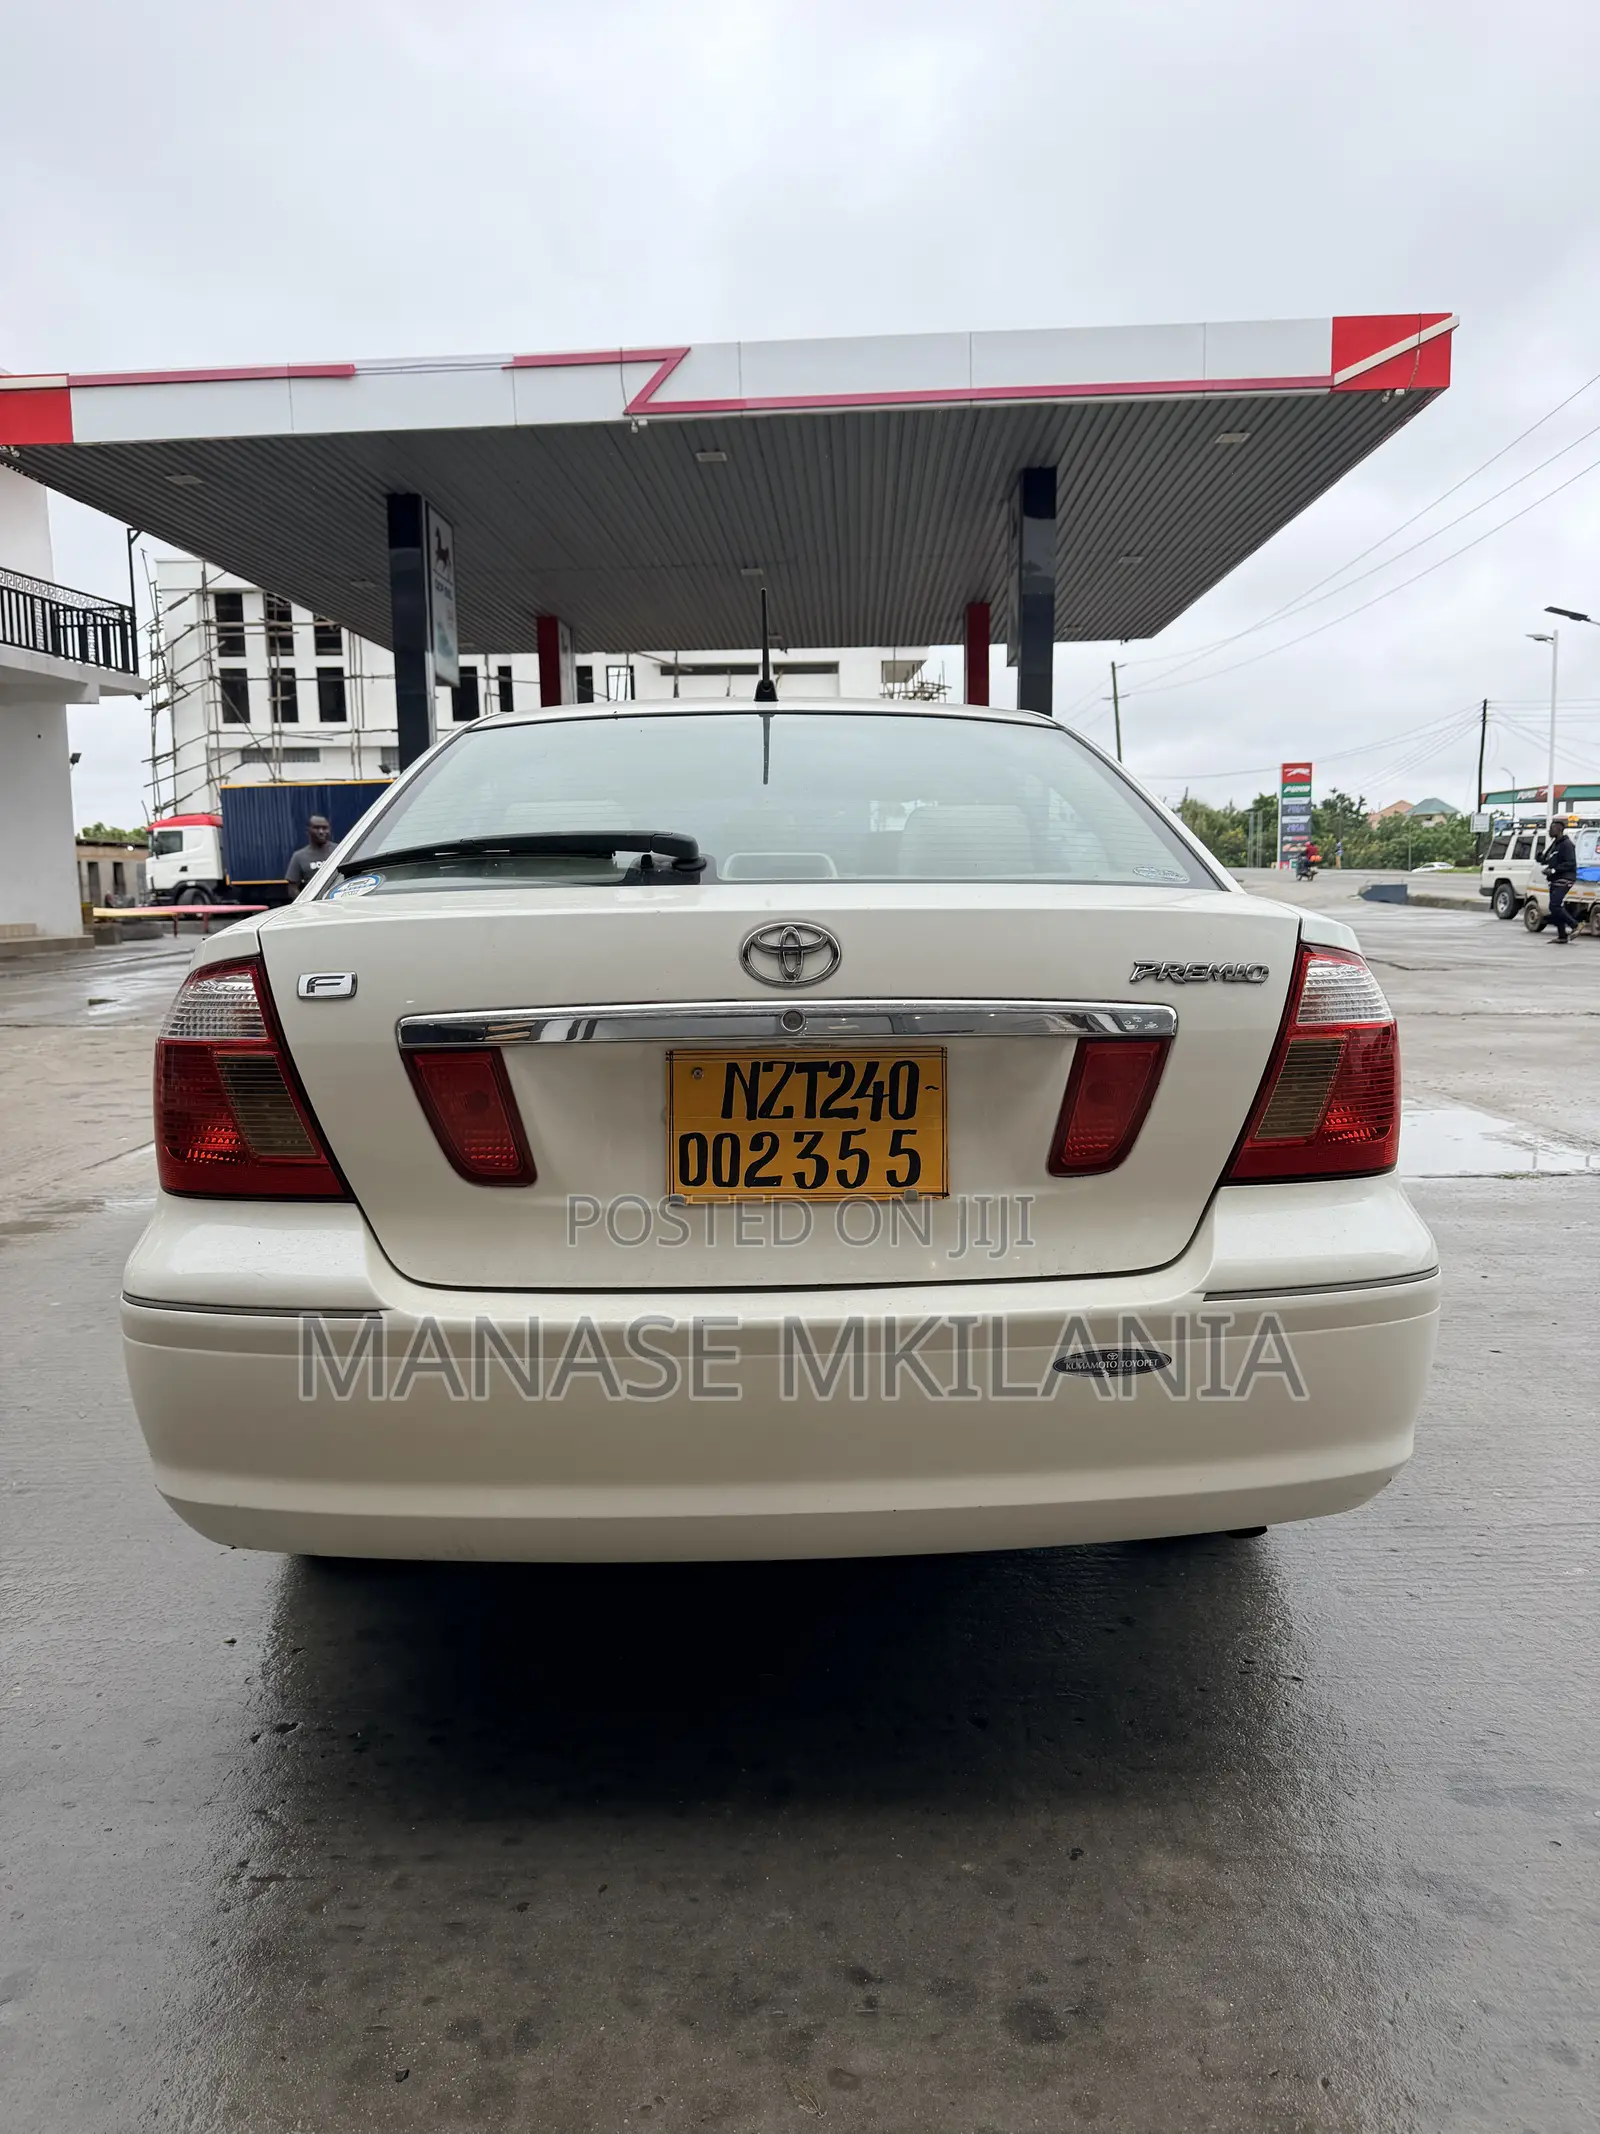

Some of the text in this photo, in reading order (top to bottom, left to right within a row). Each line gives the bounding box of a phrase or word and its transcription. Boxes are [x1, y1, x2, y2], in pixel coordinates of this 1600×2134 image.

[1129, 961, 1270, 984] PREMIO
[678, 1128, 921, 1189] 002355
[1065, 1358, 1159, 1370] KUMAMOTO TOYOPET
